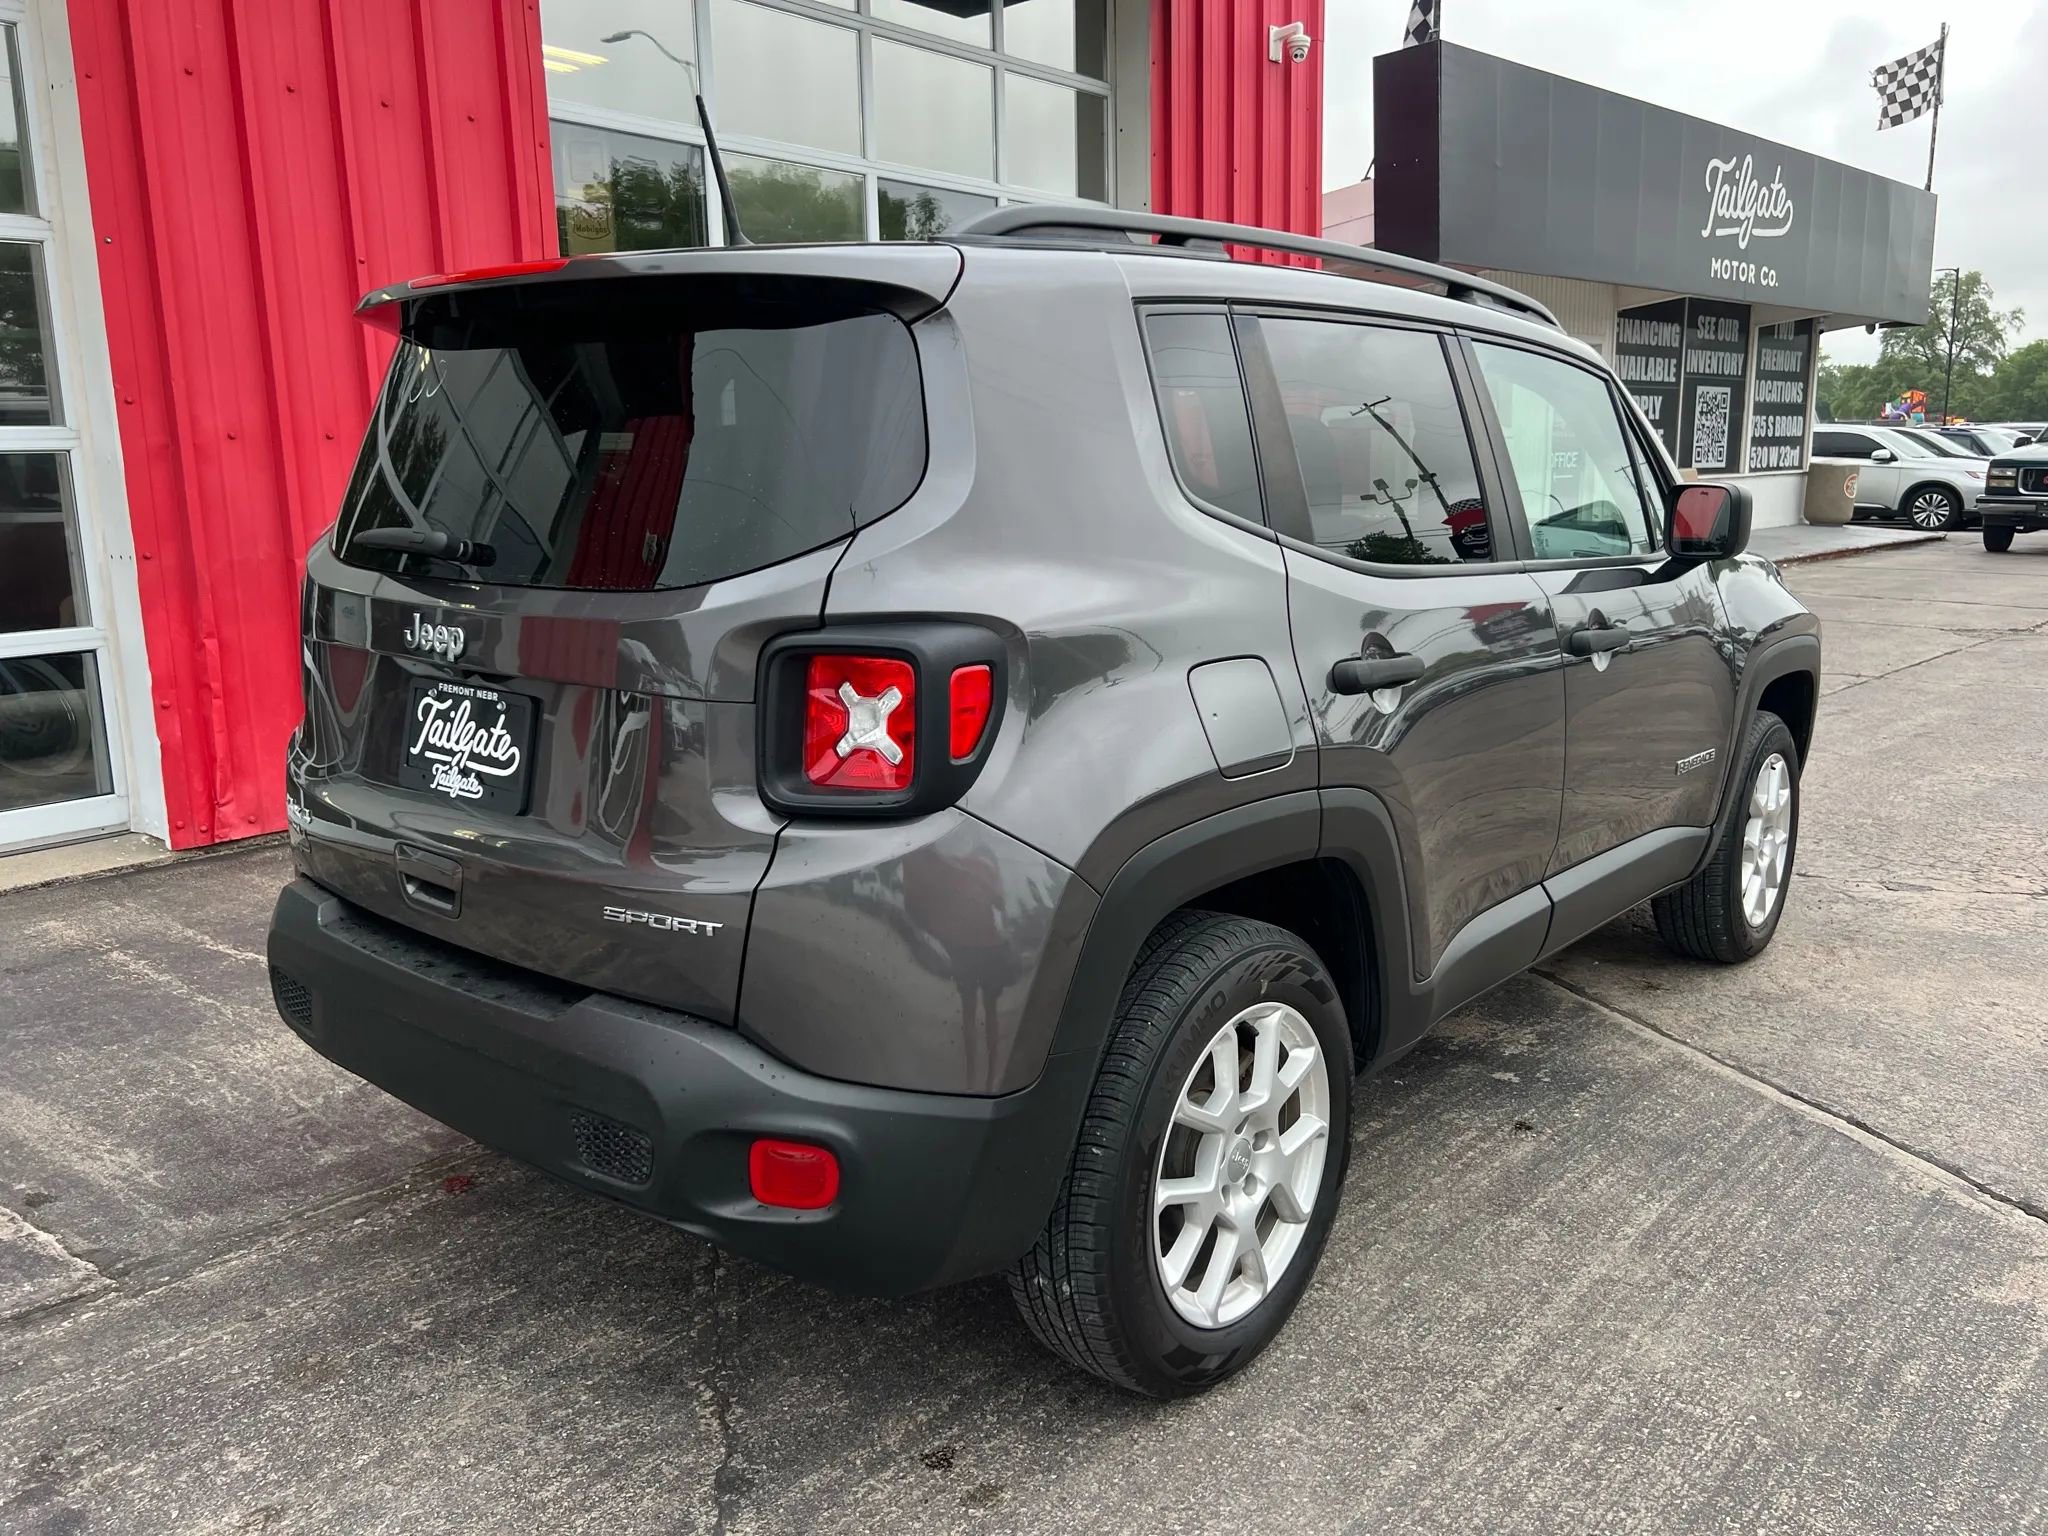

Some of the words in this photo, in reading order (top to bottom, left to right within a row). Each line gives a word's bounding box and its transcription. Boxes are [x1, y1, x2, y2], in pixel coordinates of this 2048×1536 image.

[1701, 154, 1794, 250] Tailgate
[576, 223, 608, 236] Mobilgas
[1710, 257, 1756, 284] MOTOR
[1760, 266, 1779, 287] CO.
[1697, 314, 1717, 340] SEE
[1717, 317, 1740, 343] OUR
[1686, 349, 1744, 376] INVENTORY
[1760, 348, 1803, 373] FREMONT
[1755, 380, 1804, 404] LOCATIONS
[1632, 394, 1663, 420] PLY
[1767, 415, 1774, 437] S
[1775, 415, 1804, 437] BROAD
[1552, 451, 1579, 468] FFICE
[1750, 446, 1768, 469] 520
[1769, 446, 1779, 468] W
[1779, 445, 1800, 467] 23rd
[403, 612, 465, 662] Jeep
[438, 682, 475, 697] FREMONT
[476, 689, 499, 702] NEBR
[409, 696, 521, 777] Tailgate
[1675, 748, 1716, 776] RENEGADE
[429, 763, 484, 799] Tailgate
[603, 905, 724, 937] SPORT
[1231, 1151, 1249, 1169] Jeep
